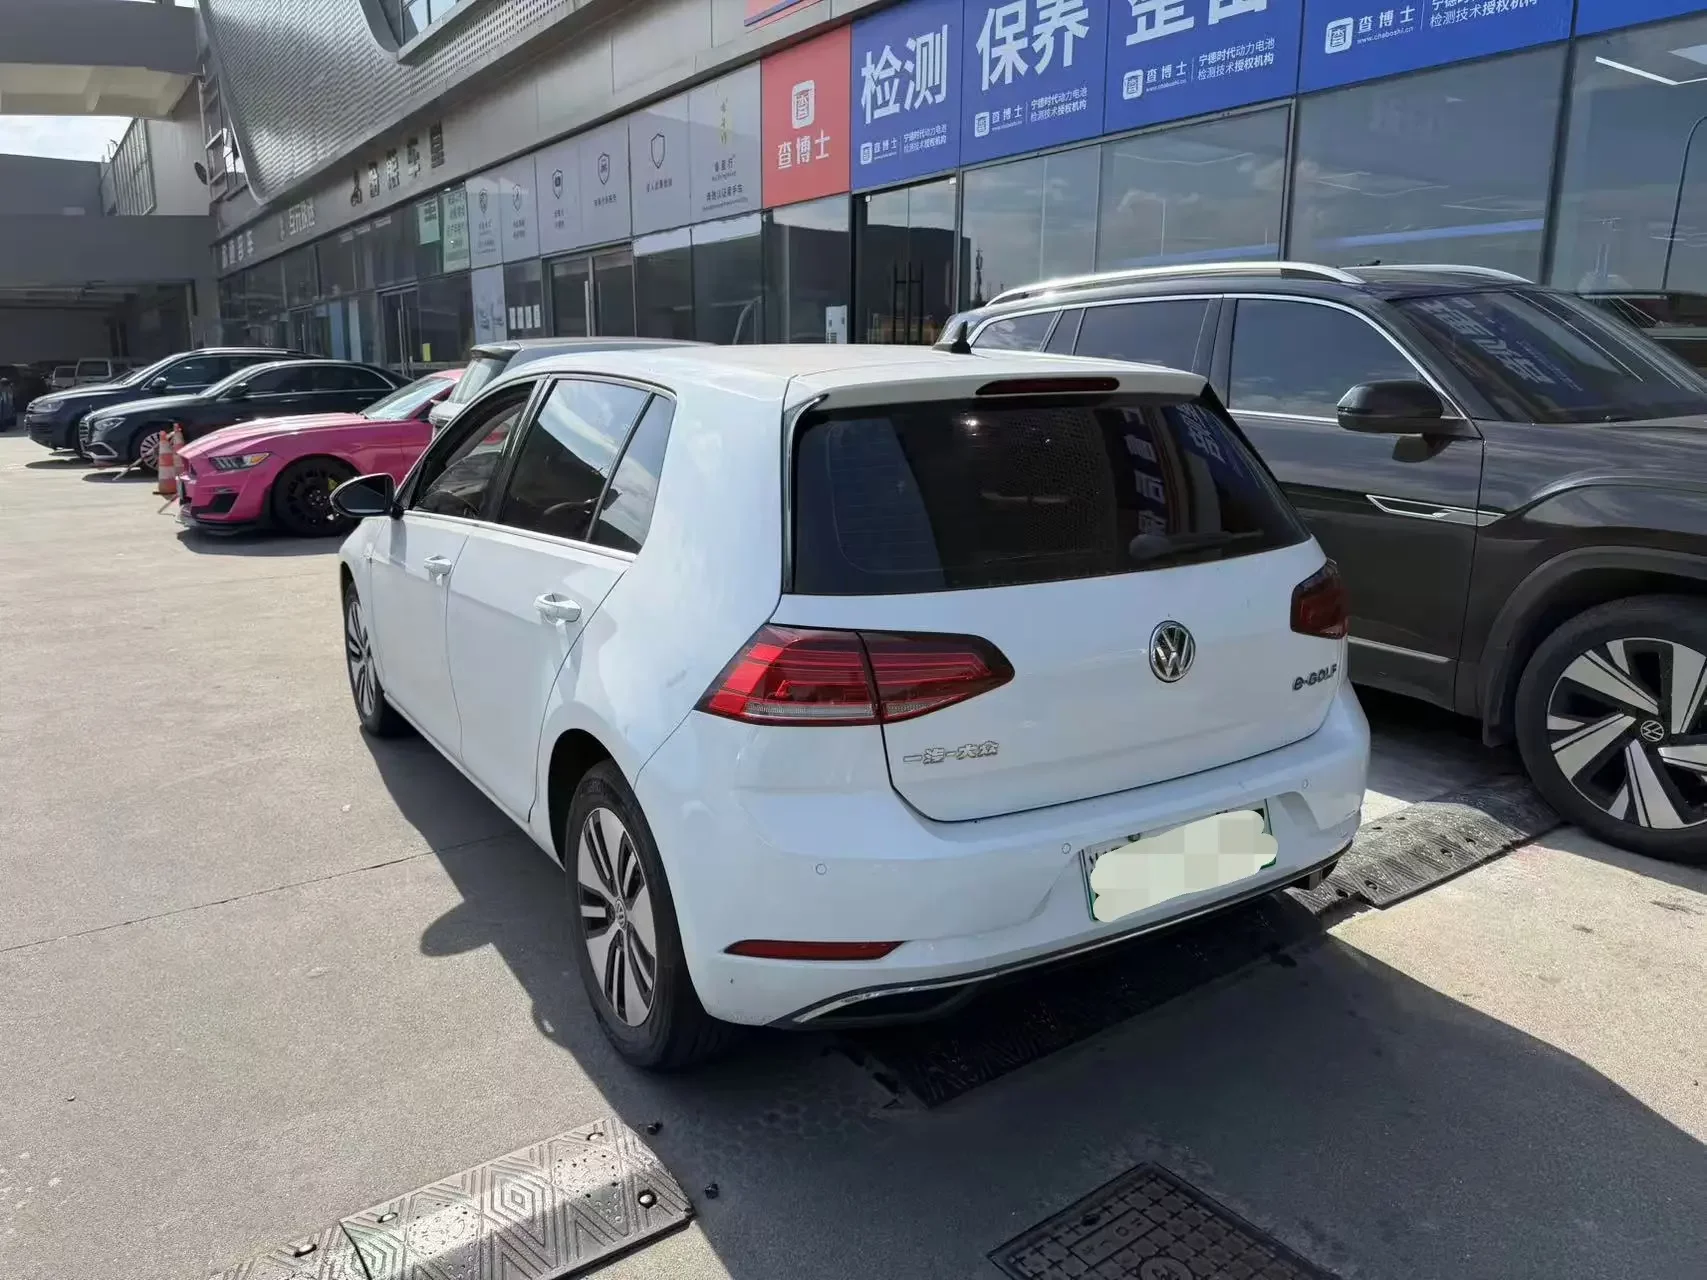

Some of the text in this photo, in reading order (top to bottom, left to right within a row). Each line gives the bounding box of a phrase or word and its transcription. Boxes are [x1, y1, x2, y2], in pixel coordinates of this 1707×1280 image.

[1357, 6, 1416, 34] 查博士
[976, 0, 1089, 91] 保养
[1198, 38, 1275, 67] 宁德时代动力电池
[862, 24, 948, 124] 检测
[1198, 52, 1275, 81] 检测技术授权机构
[778, 129, 831, 170] 查博士
